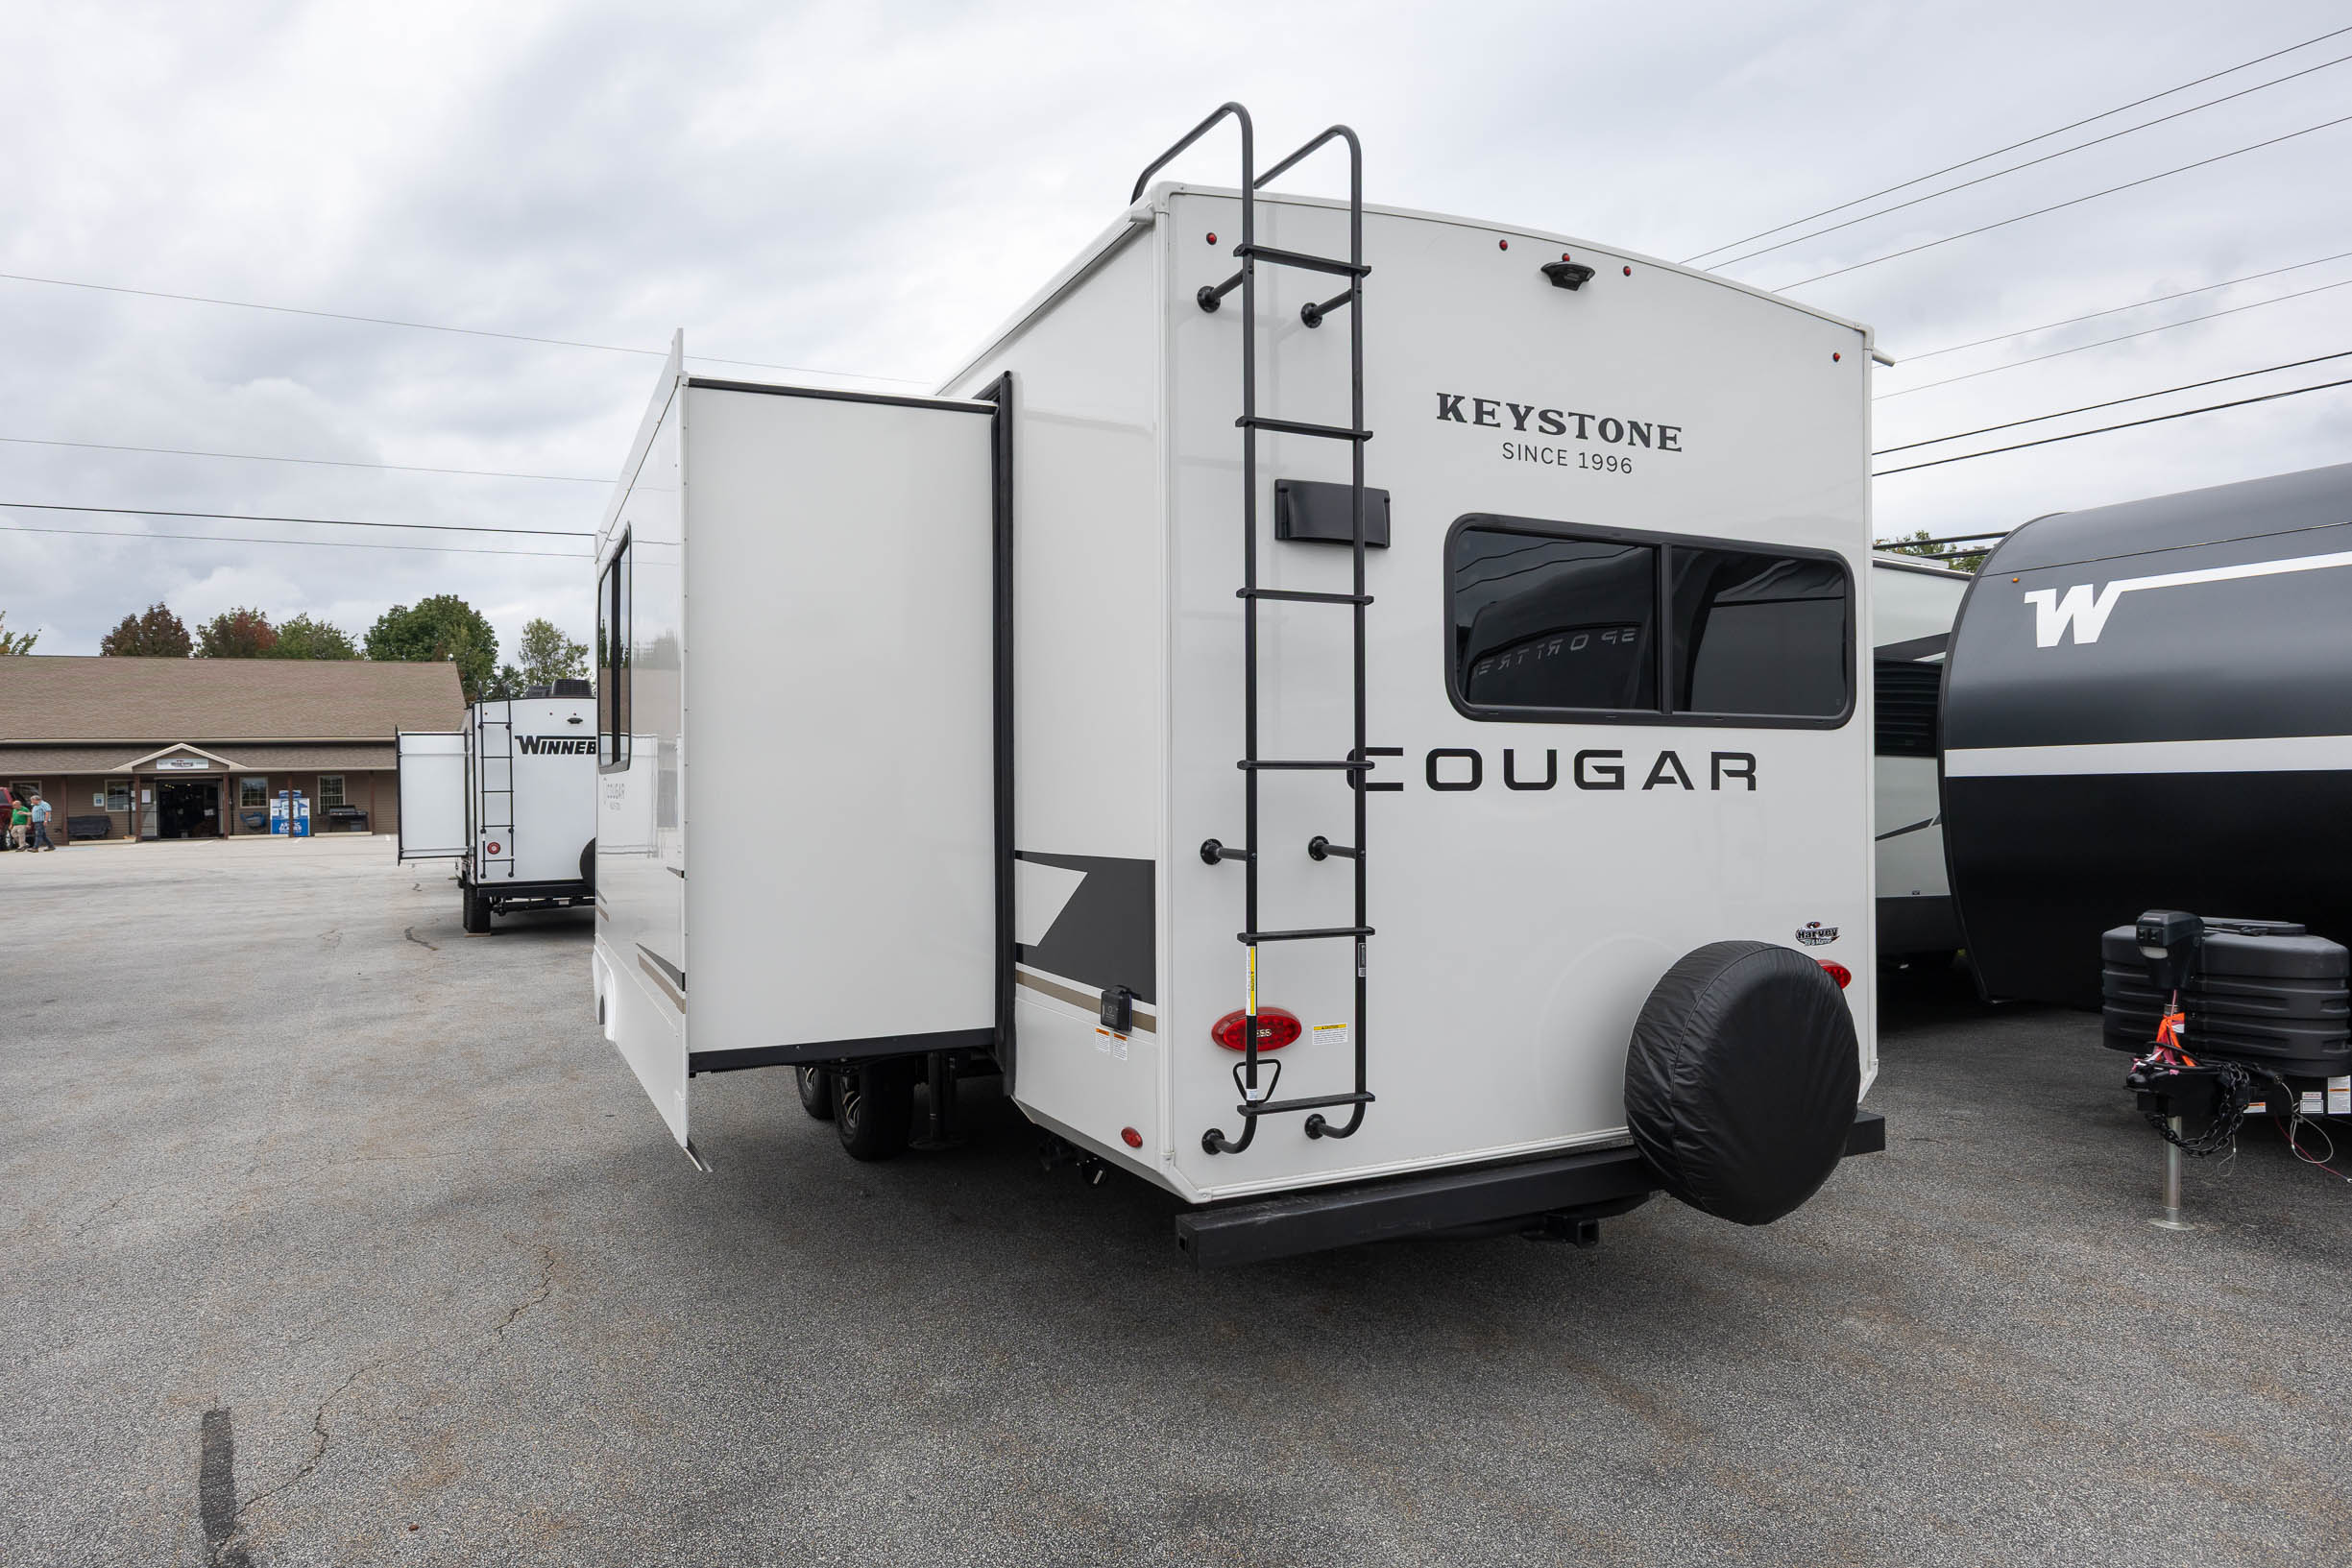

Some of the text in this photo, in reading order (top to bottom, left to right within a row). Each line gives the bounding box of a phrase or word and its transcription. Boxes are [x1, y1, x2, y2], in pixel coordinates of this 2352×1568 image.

[1436, 392, 1683, 453] KEYSTONE
[1501, 442, 1633, 475] SINCE 1996
[2024, 583, 2123, 649] W
[1346, 746, 1758, 792] COUGAR
[1797, 929, 1838, 939] Harvey
